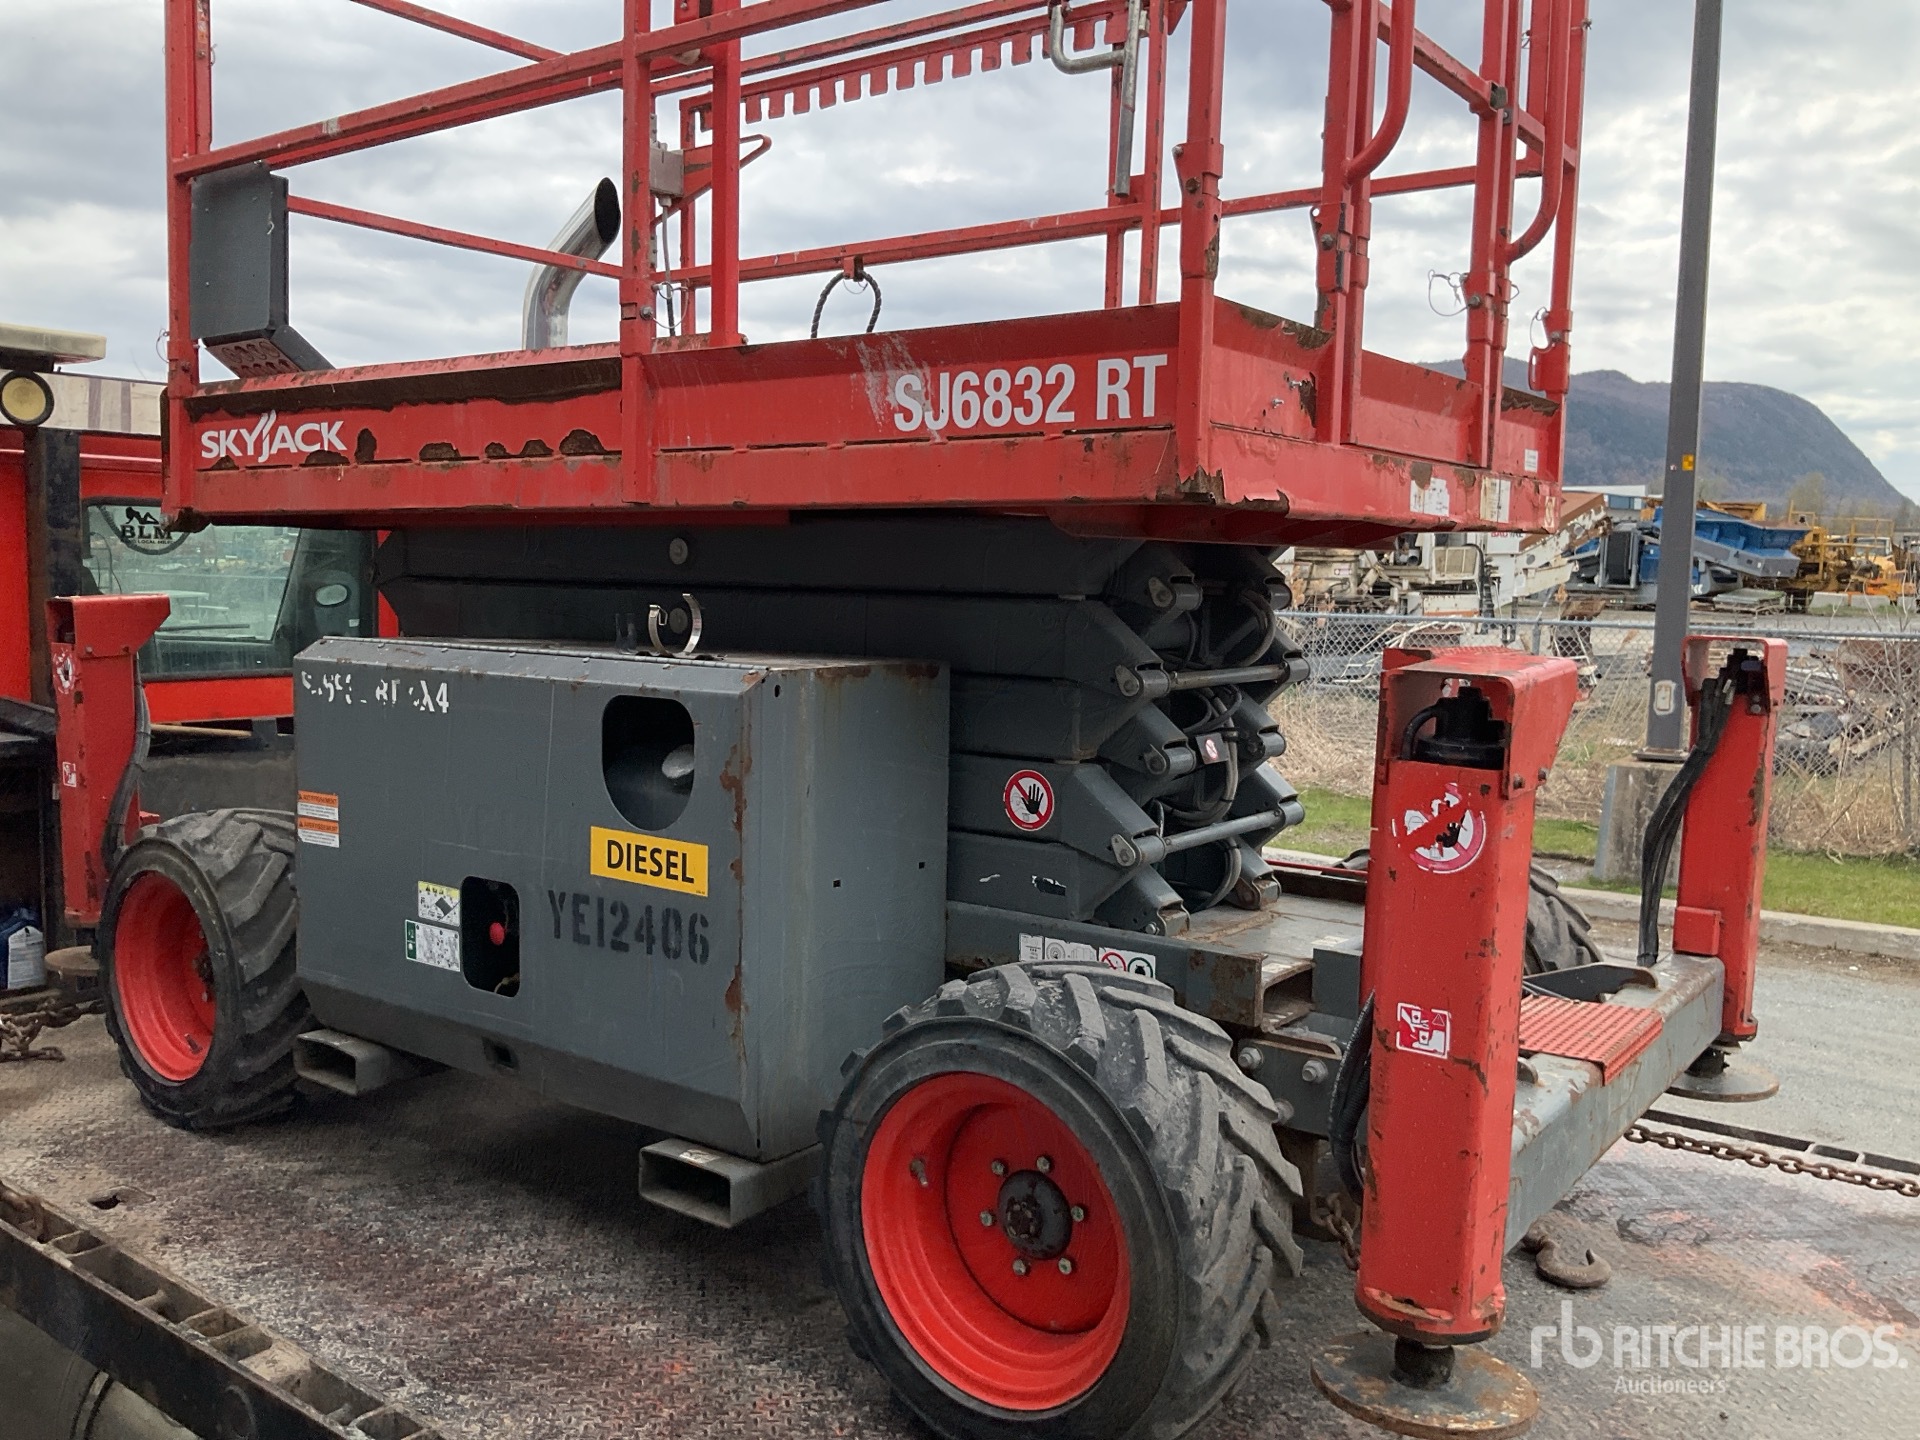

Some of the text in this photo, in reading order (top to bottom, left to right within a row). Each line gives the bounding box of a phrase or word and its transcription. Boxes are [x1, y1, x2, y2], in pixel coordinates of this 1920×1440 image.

[894, 354, 1168, 432] SJ6832 RT
[201, 409, 347, 463] SKYJACK
[120, 524, 173, 540] BLM
[607, 839, 695, 884] DIESEL
